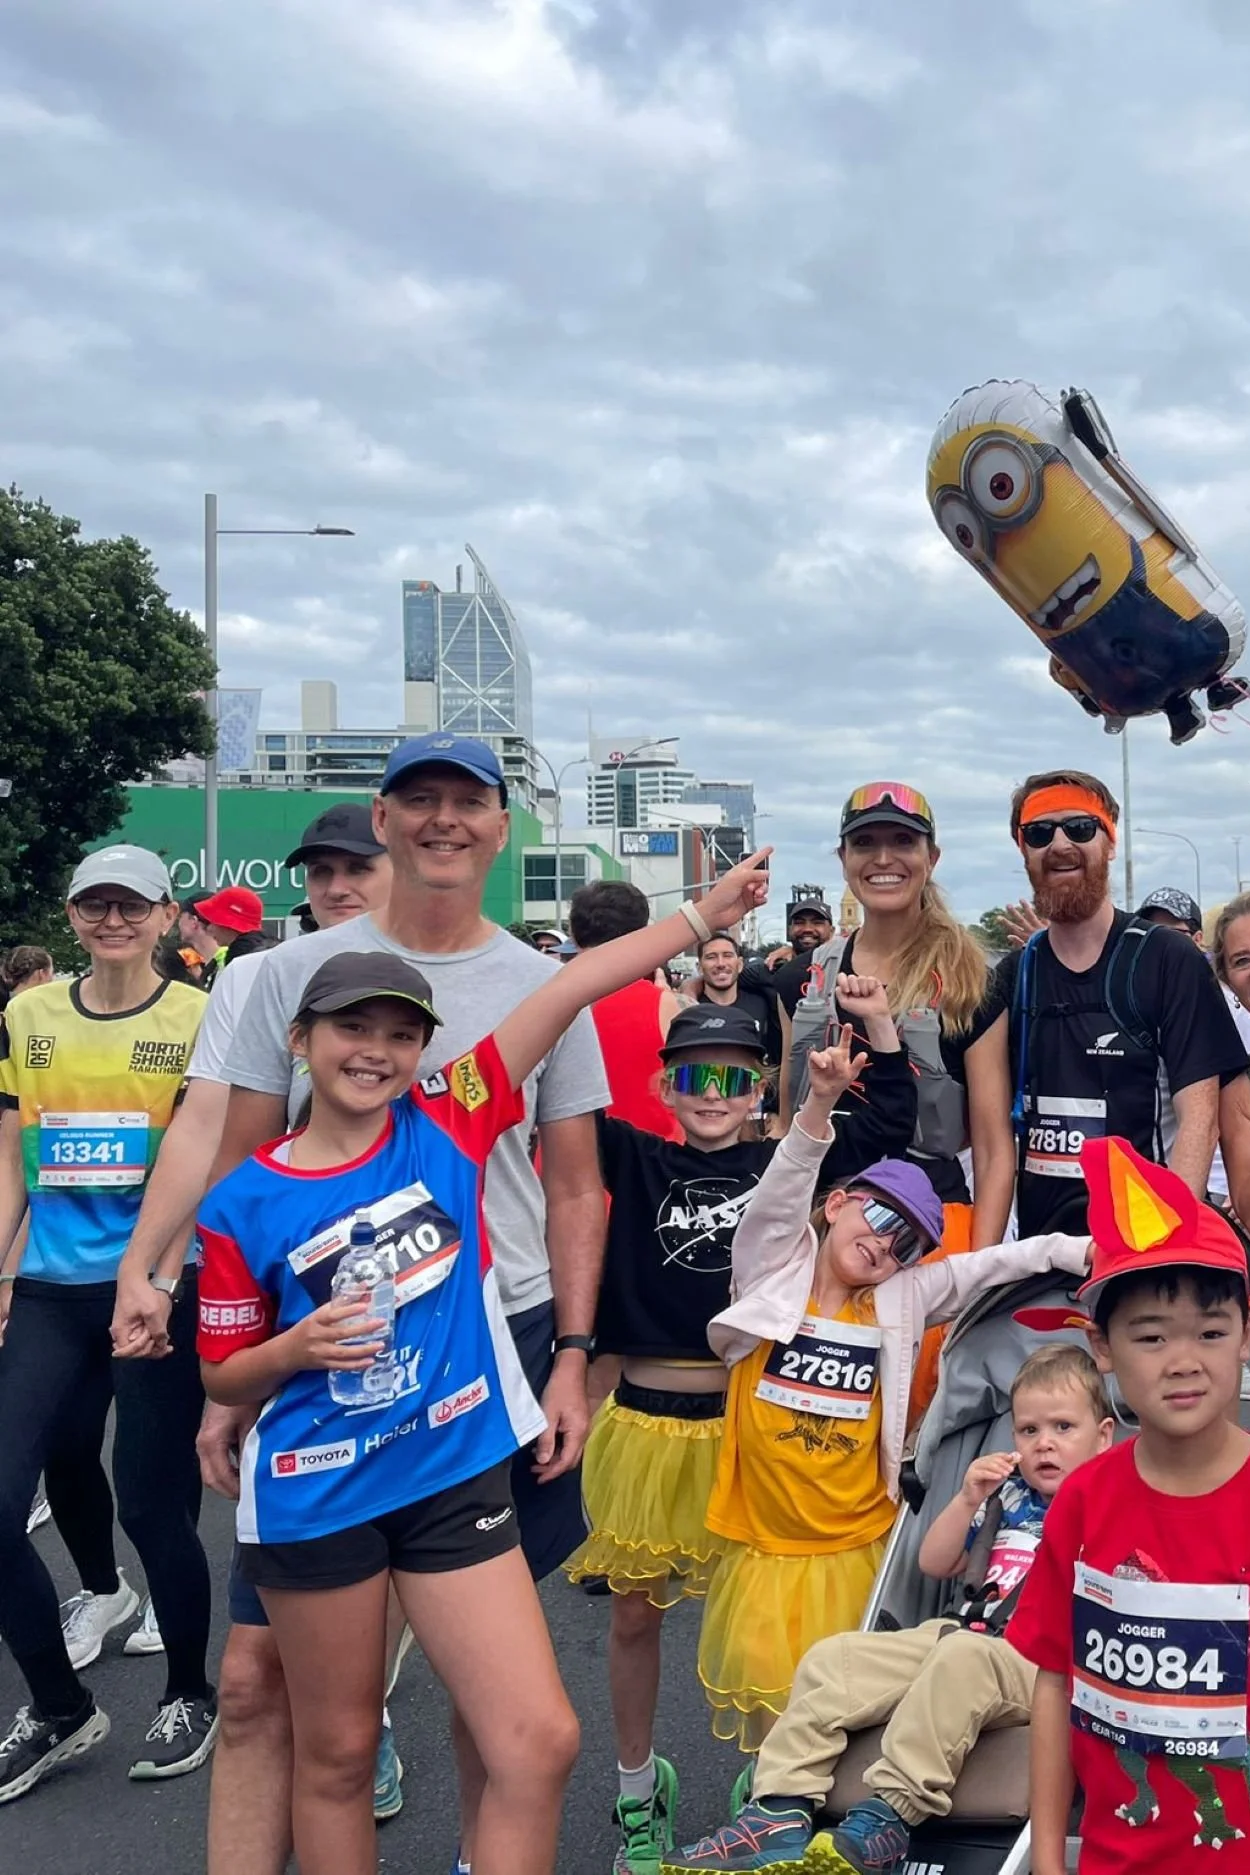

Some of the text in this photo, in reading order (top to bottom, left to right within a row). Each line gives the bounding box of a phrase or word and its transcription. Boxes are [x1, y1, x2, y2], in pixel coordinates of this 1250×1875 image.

[164, 849, 308, 888] olwort
[133, 1040, 187, 1054] NORTH
[128, 1064, 184, 1075] MARATHON
[130, 1053, 185, 1068] SHORE
[1028, 1128, 1085, 1154] 27819
[51, 1142, 125, 1163] 13341
[201, 1304, 259, 1326] REBEL
[816, 1344, 850, 1358] JOGGER
[779, 1350, 875, 1391] 27816
[300, 1449, 351, 1466] TOYOTA
[984, 1564, 1026, 1590] 24
[1117, 1622, 1166, 1639] JOGGER
[1085, 1628, 1224, 1691] 26984
[1091, 1720, 1126, 1745] GEAR TAG
[1164, 1739, 1220, 1757] 26984
